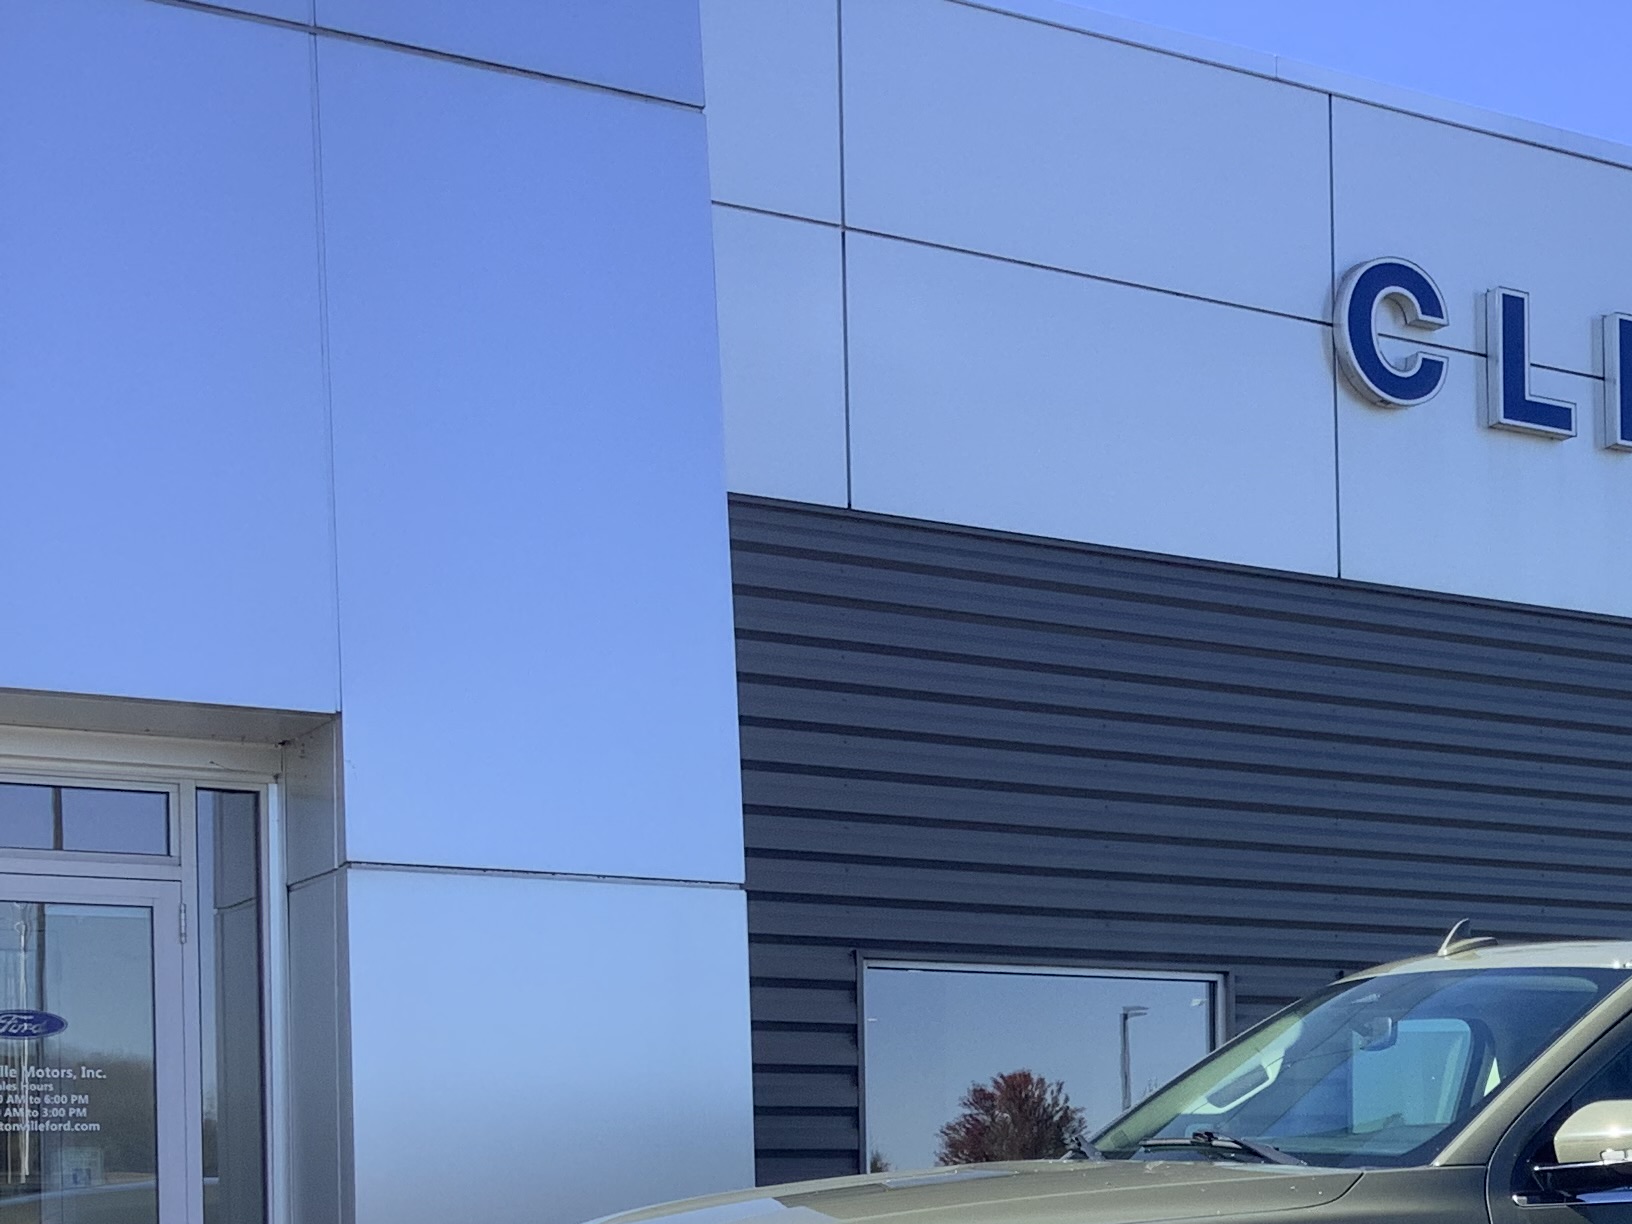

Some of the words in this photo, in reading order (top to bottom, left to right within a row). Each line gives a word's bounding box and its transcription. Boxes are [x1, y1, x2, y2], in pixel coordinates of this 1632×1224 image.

[22, 1065, 77, 1080] Motors,
[81, 1066, 107, 1079] Inc.
[21, 1081, 54, 1091] Hours
[6, 1095, 26, 1104] AM
[29, 1095, 41, 1104] to
[43, 1094, 68, 1104] 6:00
[70, 1094, 89, 1104] PM
[4, 1108, 24, 1117] AM
[41, 1108, 66, 1117] 3:00
[68, 1108, 87, 1117] PM
